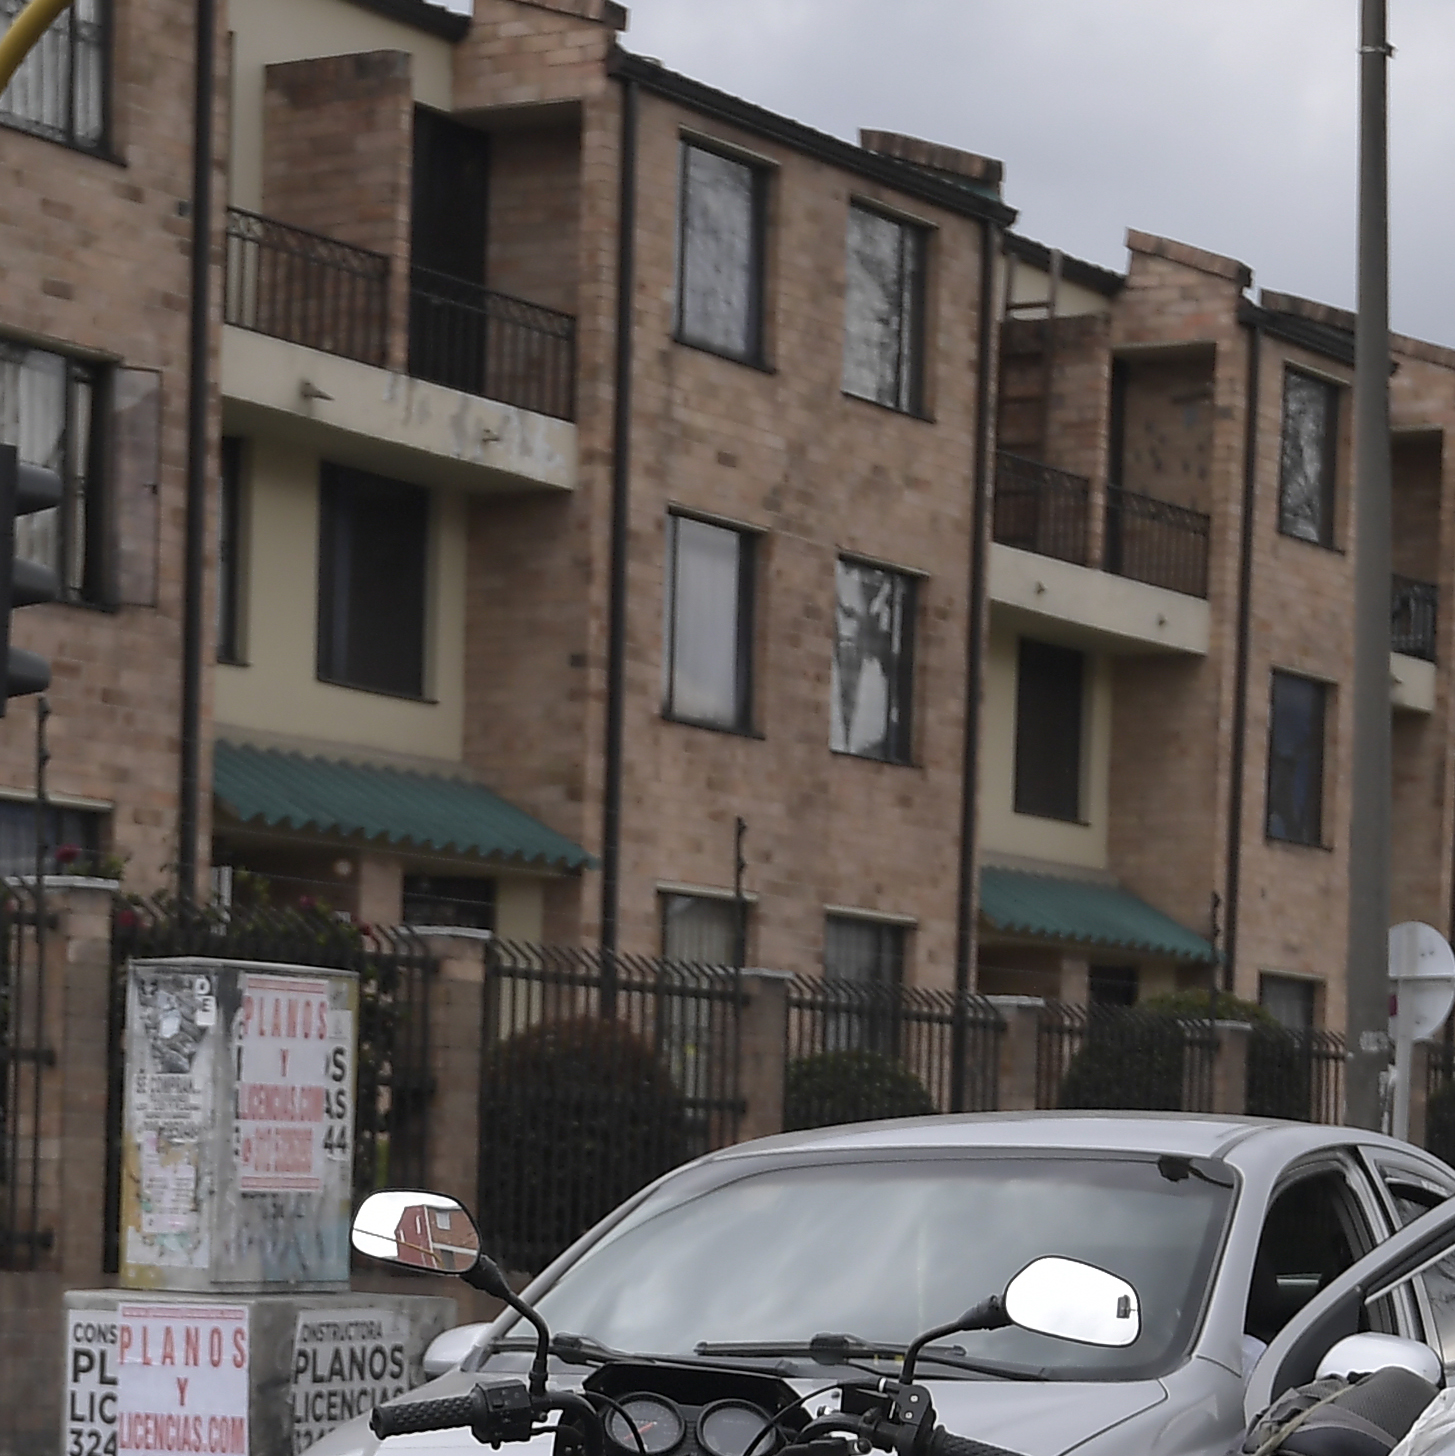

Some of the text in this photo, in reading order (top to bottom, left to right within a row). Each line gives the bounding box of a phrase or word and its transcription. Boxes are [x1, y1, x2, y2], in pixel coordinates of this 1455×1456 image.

[118, 1325, 246, 1369] PLANOS
[300, 1321, 384, 1342] ONSTRUCTORA
[72, 1348, 118, 1385] PL
[295, 1343, 405, 1384] PLANOS
[176, 1377, 189, 1407] Y
[294, 1385, 405, 1424] LICENCIA
[119, 1412, 244, 1454] LICENCIAS.COM
